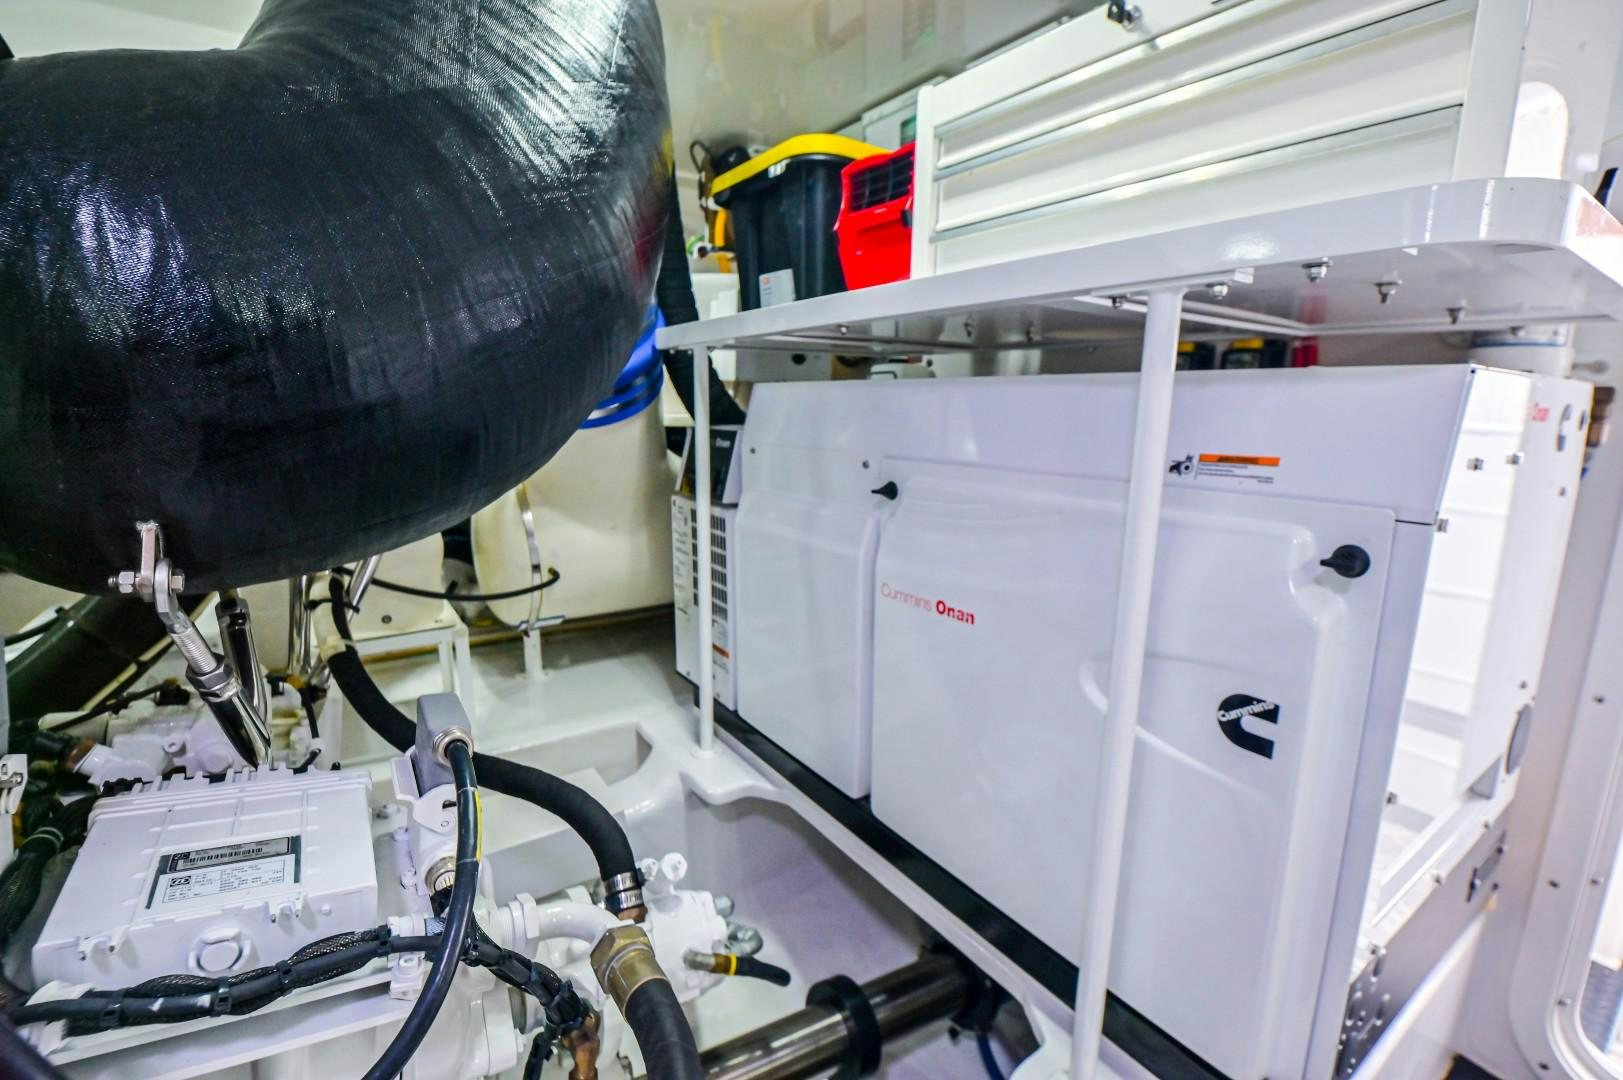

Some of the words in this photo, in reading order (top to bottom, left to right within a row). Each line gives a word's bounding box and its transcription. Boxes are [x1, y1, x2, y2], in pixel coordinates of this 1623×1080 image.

[880, 582, 932, 612] Cummins
[936, 599, 975, 625] Onan
[1218, 701, 1276, 722] Cummins
